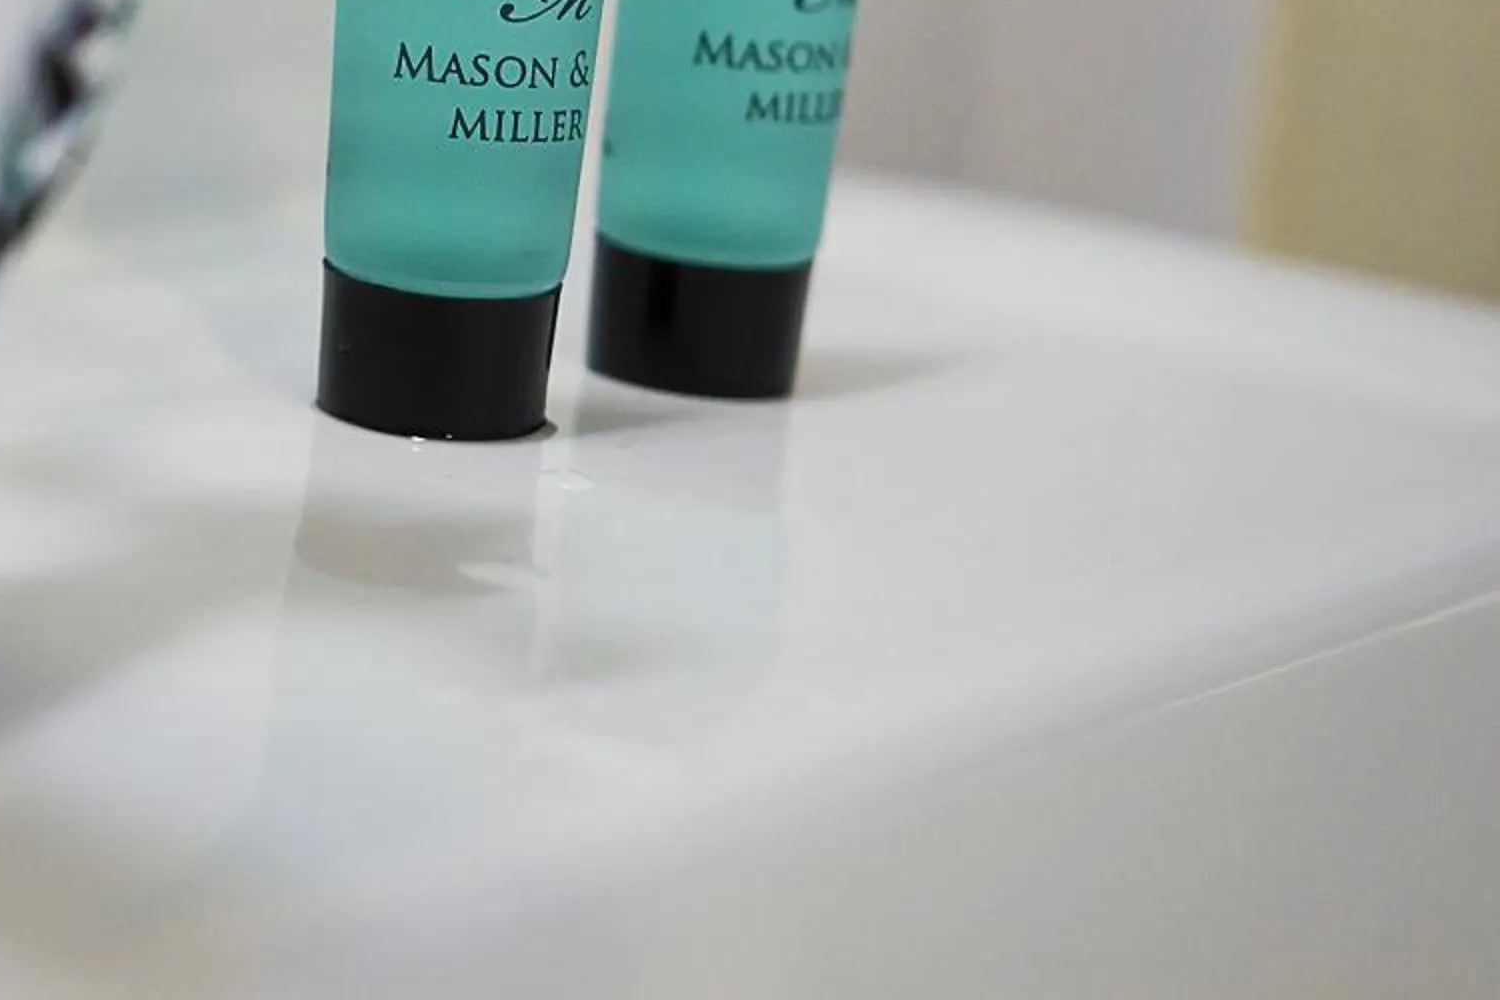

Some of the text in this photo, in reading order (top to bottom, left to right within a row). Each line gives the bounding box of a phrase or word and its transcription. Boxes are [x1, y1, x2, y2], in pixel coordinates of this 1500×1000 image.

[394, 42, 590, 89] MASON &
[693, 30, 836, 74] MASON
[448, 107, 582, 143] MILLER
[744, 88, 844, 125] MILLE
